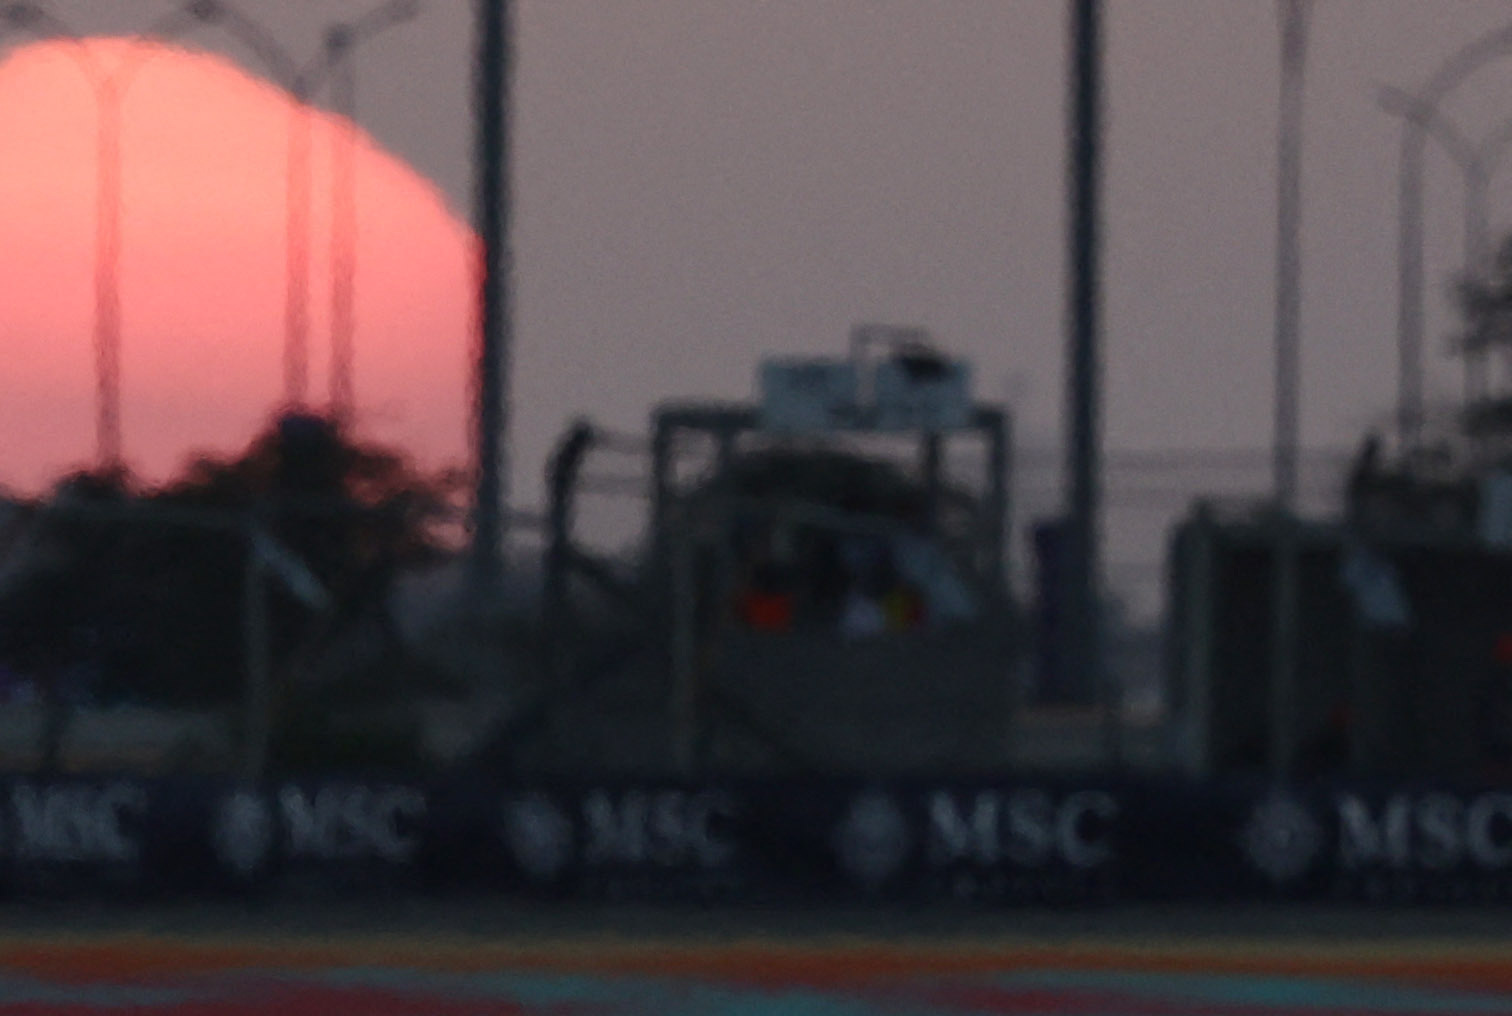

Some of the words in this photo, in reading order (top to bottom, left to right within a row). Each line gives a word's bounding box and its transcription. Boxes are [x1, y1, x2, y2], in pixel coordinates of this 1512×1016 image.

[280, 782, 426, 862] MSC
[580, 785, 740, 866] MSC
[924, 789, 1122, 868] MSC
[1336, 791, 1512, 869] MSC
